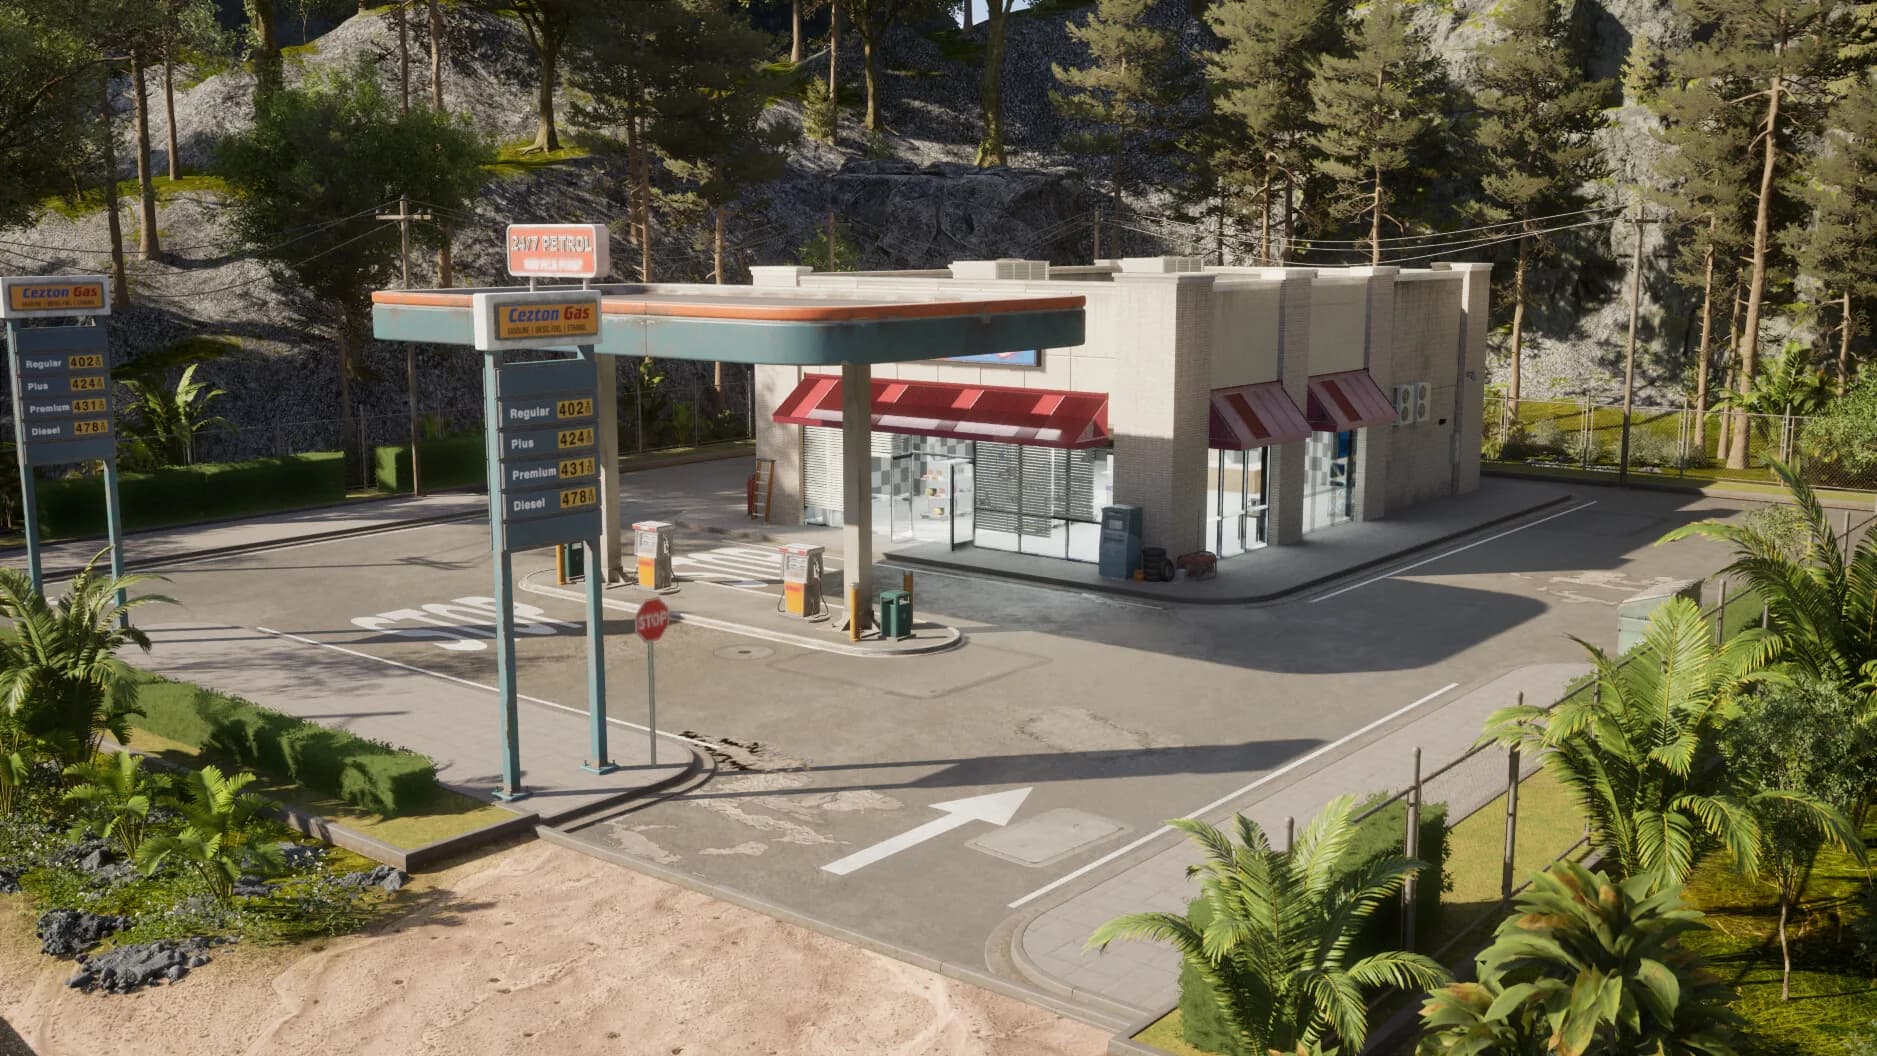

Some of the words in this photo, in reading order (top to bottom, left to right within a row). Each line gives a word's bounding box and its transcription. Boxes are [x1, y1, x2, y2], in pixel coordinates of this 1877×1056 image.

[511, 234, 539, 253] 24/7
[541, 234, 593, 254] PETROL
[73, 286, 97, 297] Gas
[508, 307, 559, 323] Cezton
[563, 305, 590, 321] Gas
[26, 359, 62, 370] Regular
[70, 356, 94, 367] 402
[27, 382, 49, 391] Plus
[72, 378, 96, 389] 424
[29, 404, 70, 413] Premium
[74, 401, 96, 411] 431
[510, 407, 550, 420] Regular
[559, 402, 584, 416] 402
[31, 426, 60, 436] Diesel
[511, 439, 535, 450] Plus
[560, 431, 585, 446] 424
[512, 467, 557, 480] Premium
[561, 461, 585, 476] 431
[513, 498, 546, 511] Diesel
[562, 490, 587, 505] 478
[639, 609, 667, 630] STOP
